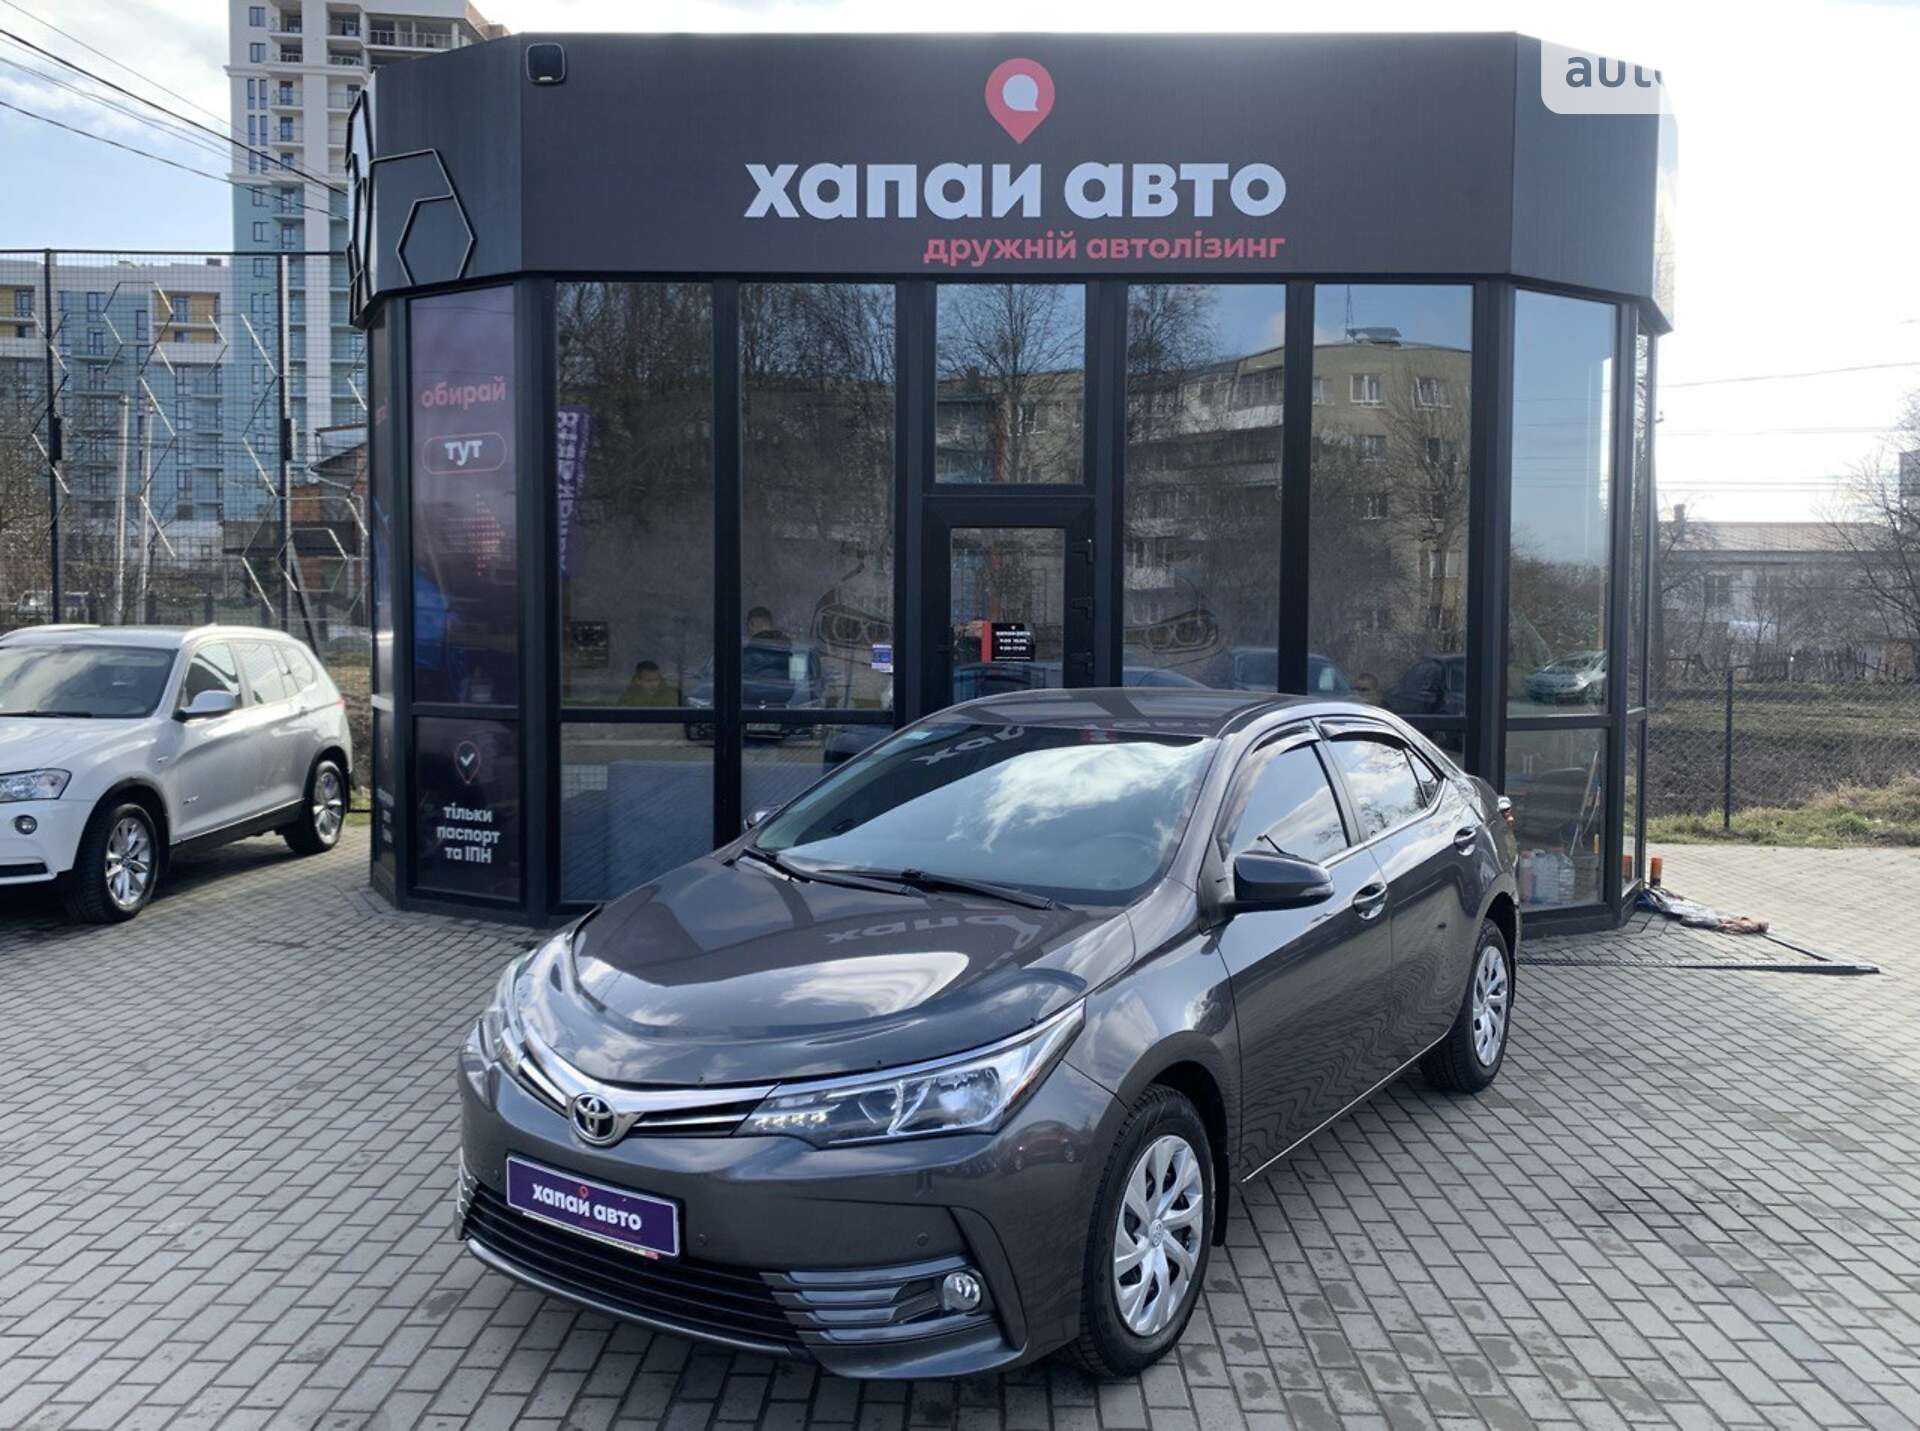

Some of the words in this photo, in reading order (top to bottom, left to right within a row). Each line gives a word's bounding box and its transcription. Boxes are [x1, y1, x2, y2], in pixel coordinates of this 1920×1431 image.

[1064, 162, 1287, 220] авто
[923, 231, 1077, 267] дружній
[1086, 231, 1286, 259] автолізинг
[421, 376, 506, 410] обирай
[444, 440, 483, 466] тут
[443, 802, 493, 823] тільки
[436, 826, 501, 847] паспорт
[444, 847, 462, 860] та
[465, 846, 492, 864] ІПН
[593, 1204, 643, 1230] авто
